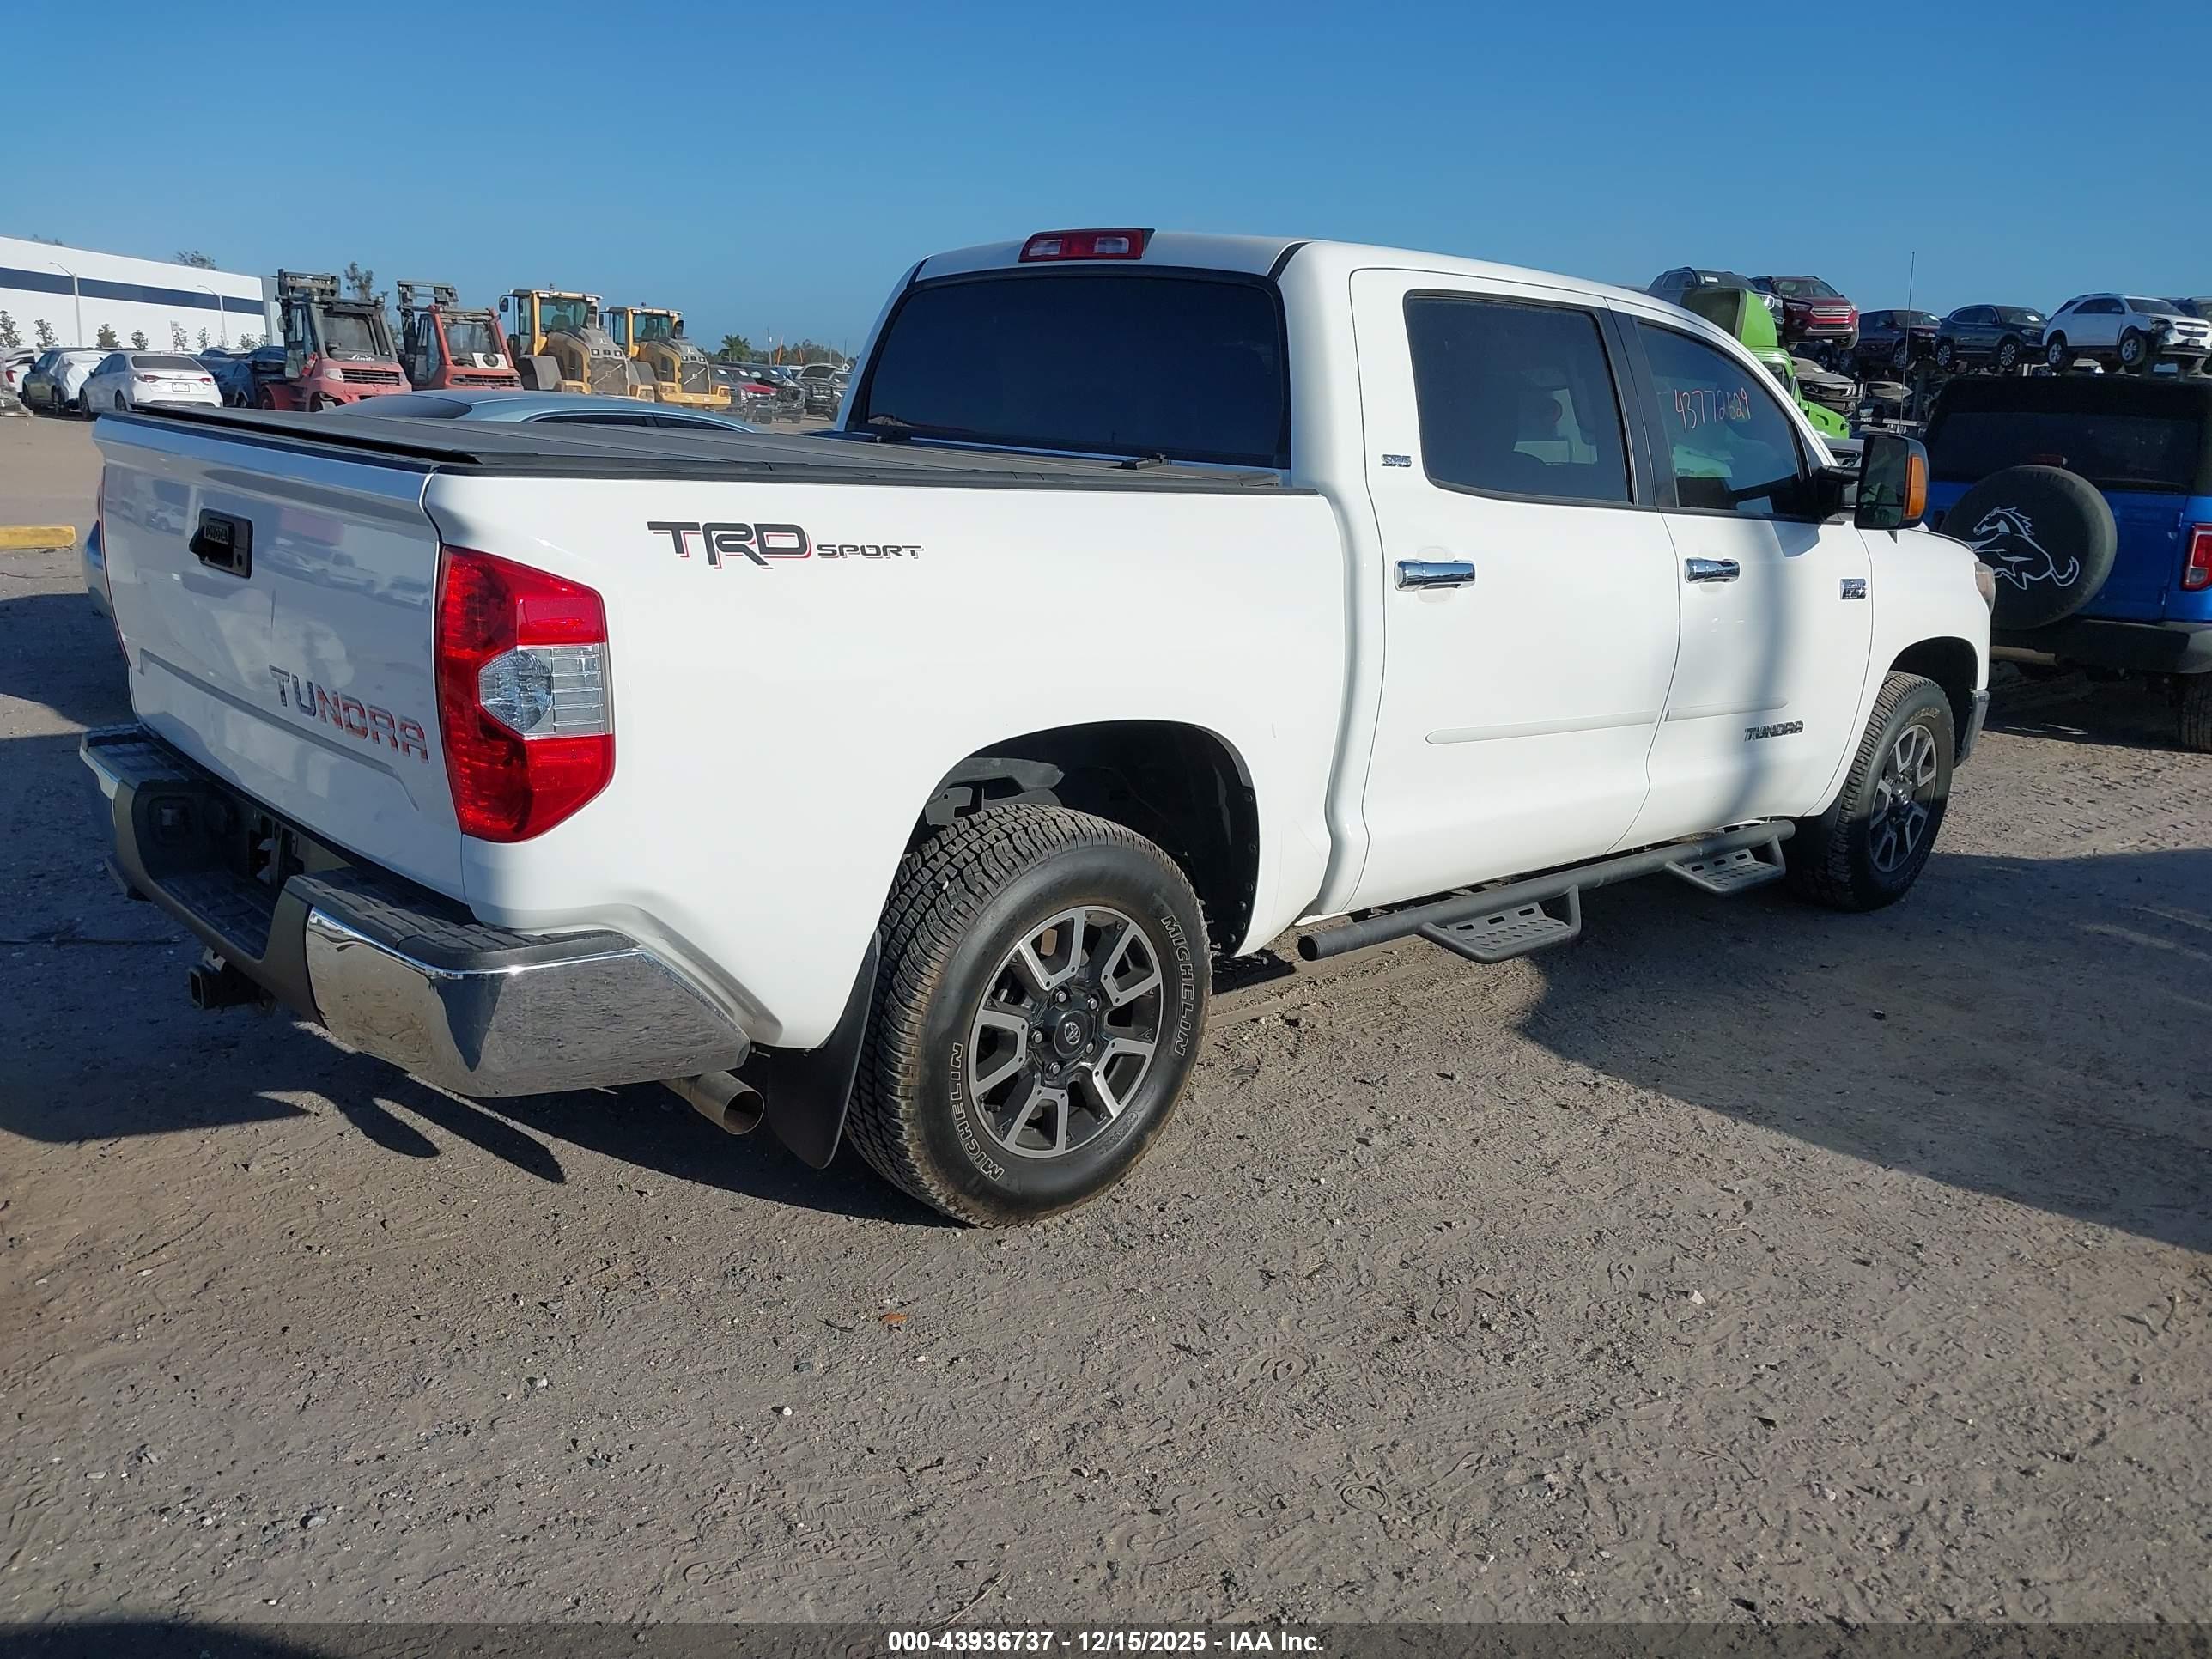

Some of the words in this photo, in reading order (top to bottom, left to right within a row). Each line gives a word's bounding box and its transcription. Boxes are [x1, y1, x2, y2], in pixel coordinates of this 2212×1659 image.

[647, 520, 812, 569] TRD
[816, 544, 925, 559] SPORT
[269, 665, 430, 764] TUNDRA
[1744, 720, 1805, 742] TUNDRA
[1161, 915, 1195, 1057] MICHELIN
[950, 1042, 1005, 1182] MICHELIN
